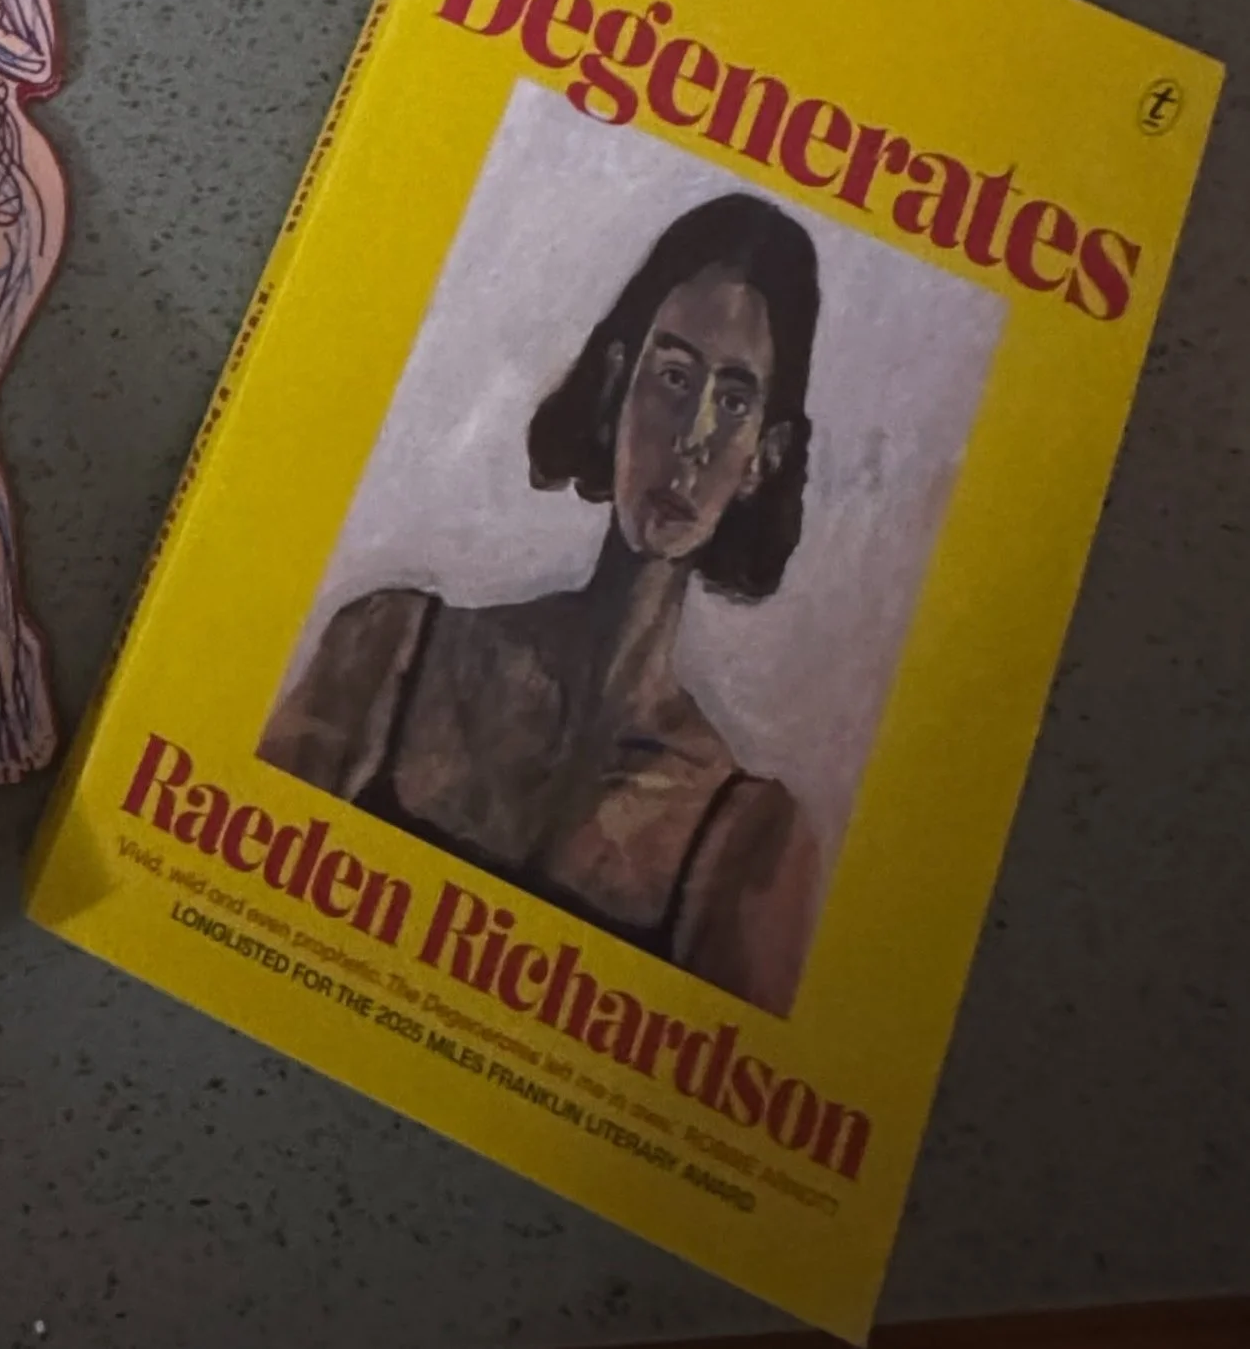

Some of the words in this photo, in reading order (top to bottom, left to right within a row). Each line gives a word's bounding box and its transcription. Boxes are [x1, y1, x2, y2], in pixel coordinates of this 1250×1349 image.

[119, 730, 414, 947] Raeden
[414, 880, 874, 1183] Richardson
[168, 863, 207, 895] wild
[206, 881, 246, 917] and
[246, 902, 292, 942] even
[385, 970, 423, 1005] The
[170, 899, 291, 977] LONGLISTED
[290, 961, 334, 996] FOR
[334, 982, 376, 1018] THE
[373, 1004, 425, 1043] 2025
[424, 1029, 487, 1075] MILES
[485, 1059, 584, 1127] FRANKLIN
[584, 1110, 680, 1173] LITERARY
[679, 1161, 758, 1216] AWARD
